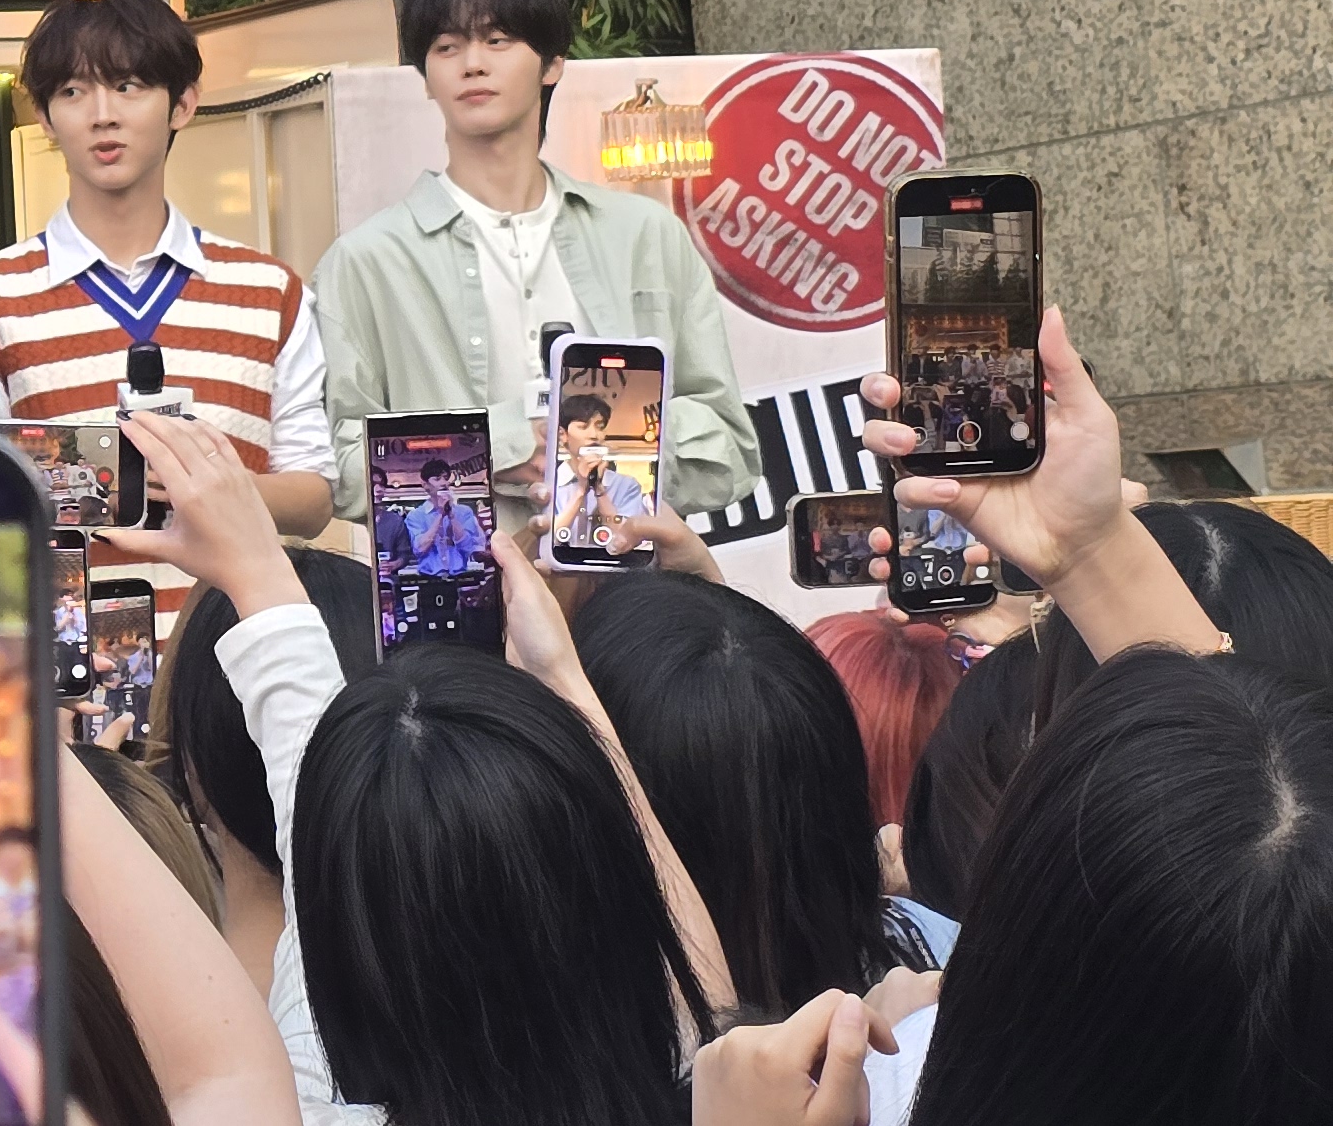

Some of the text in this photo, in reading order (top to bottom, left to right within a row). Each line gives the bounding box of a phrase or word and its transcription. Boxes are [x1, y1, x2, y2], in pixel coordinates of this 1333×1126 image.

[777, 67, 856, 142] DO
[758, 139, 879, 237] STOP
[693, 177, 860, 312] ASKING
